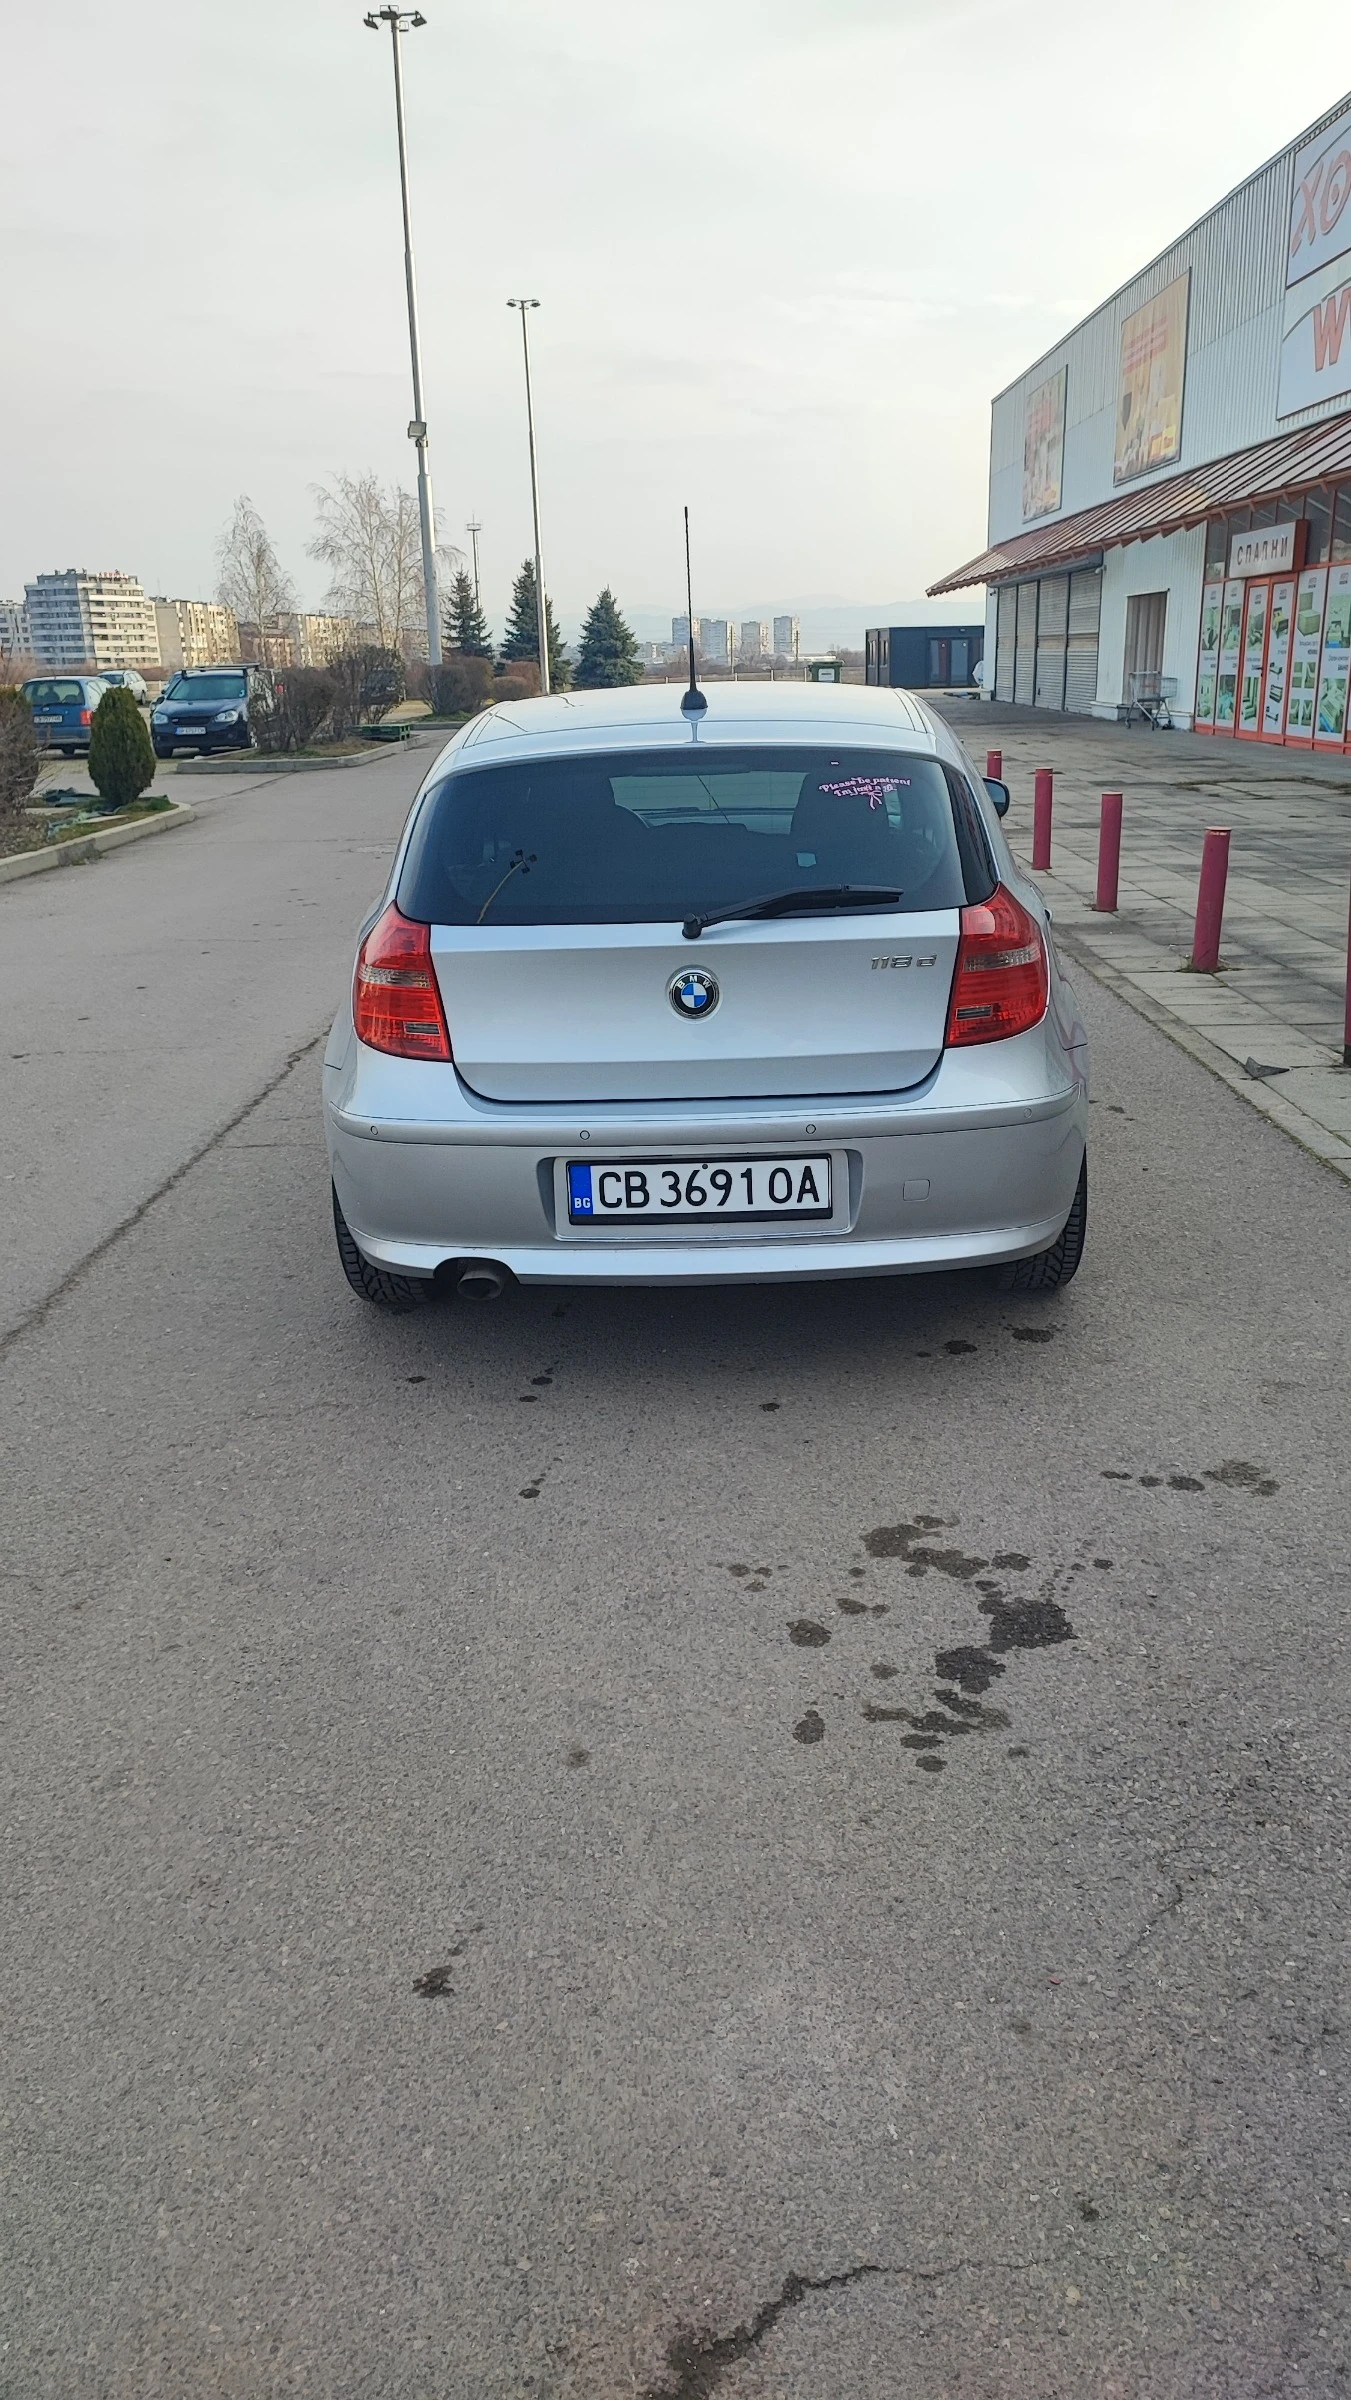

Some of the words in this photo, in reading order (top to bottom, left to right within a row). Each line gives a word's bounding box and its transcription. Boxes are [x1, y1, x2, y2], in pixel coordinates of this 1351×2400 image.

[1312, 286, 1351, 373] W
[1237, 536, 1288, 566] СПАЛНИ
[819, 780, 856, 793] Please
[851, 776, 871, 785] be
[870, 776, 911, 786] patient
[676, 975, 711, 990] BMW
[574, 1197, 591, 1209] BG
